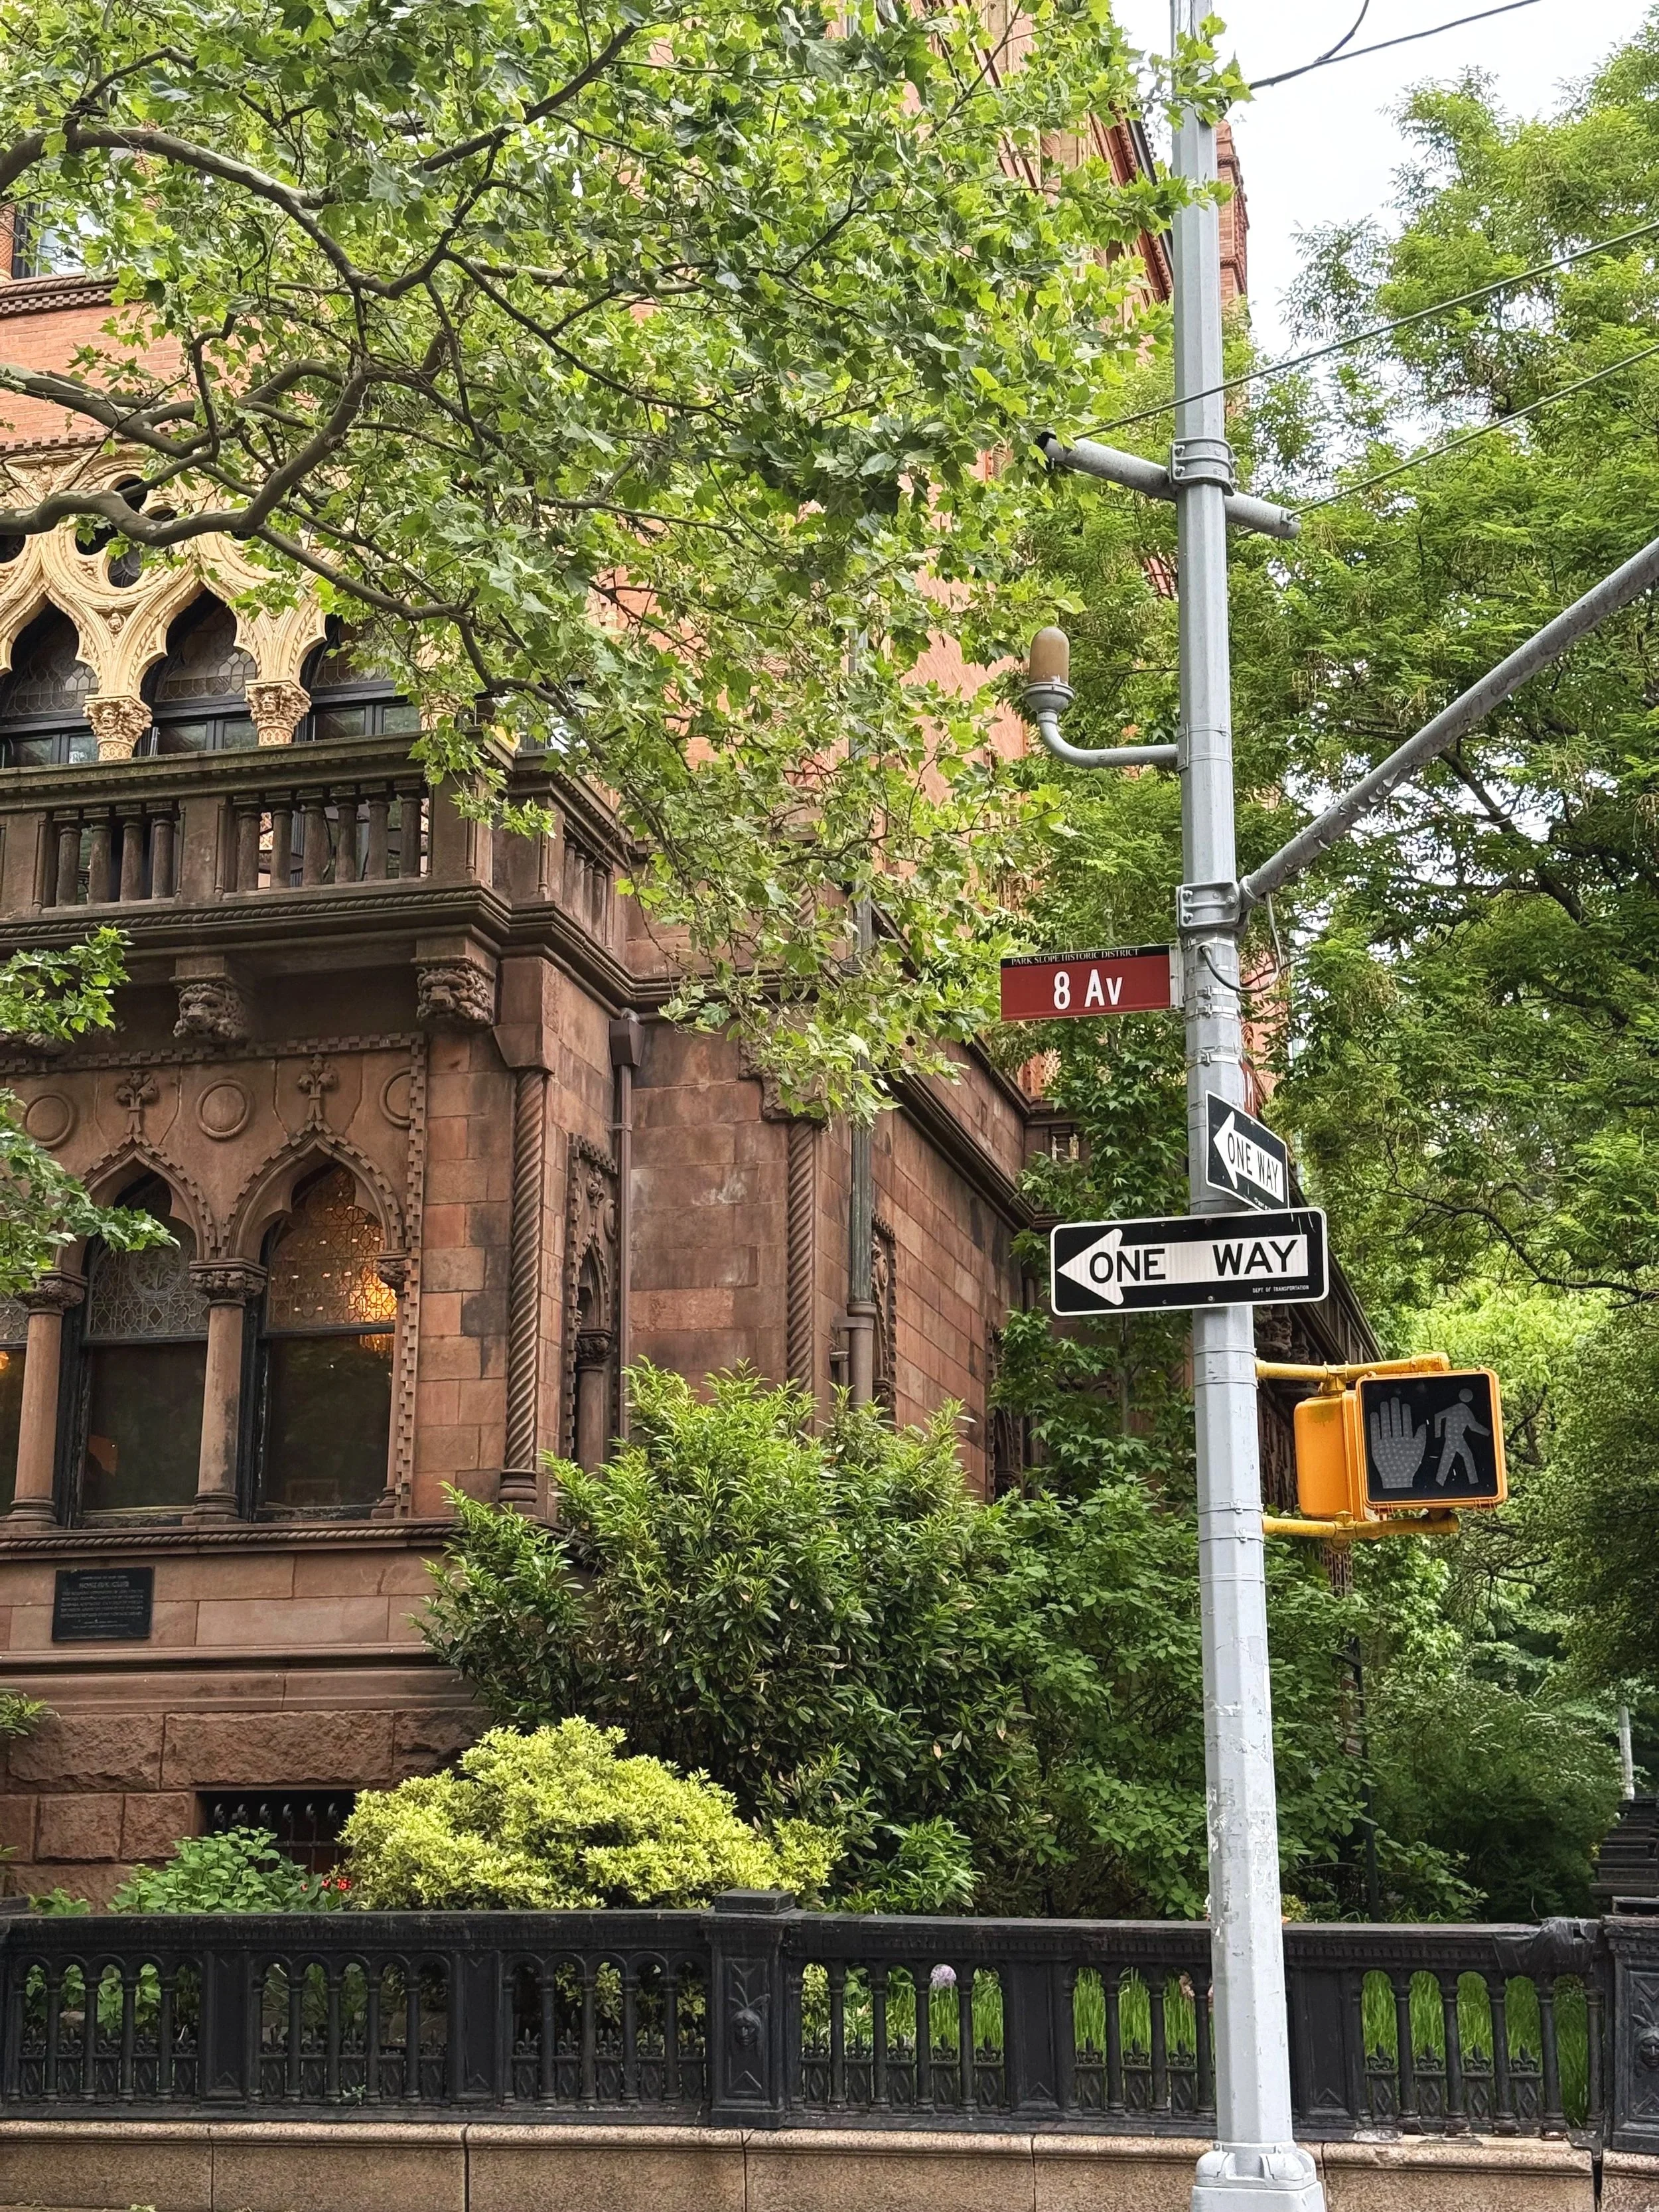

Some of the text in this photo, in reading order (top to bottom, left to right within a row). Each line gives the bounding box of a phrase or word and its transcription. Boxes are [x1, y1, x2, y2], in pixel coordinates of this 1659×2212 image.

[1011, 949, 1138, 966] PARK SLOPE HISTORIC DISTRICT
[1053, 969, 1123, 1009] 8 Av
[1227, 1132, 1278, 1193] ONE WAY
[1089, 1240, 1298, 1284] ONE WAY
